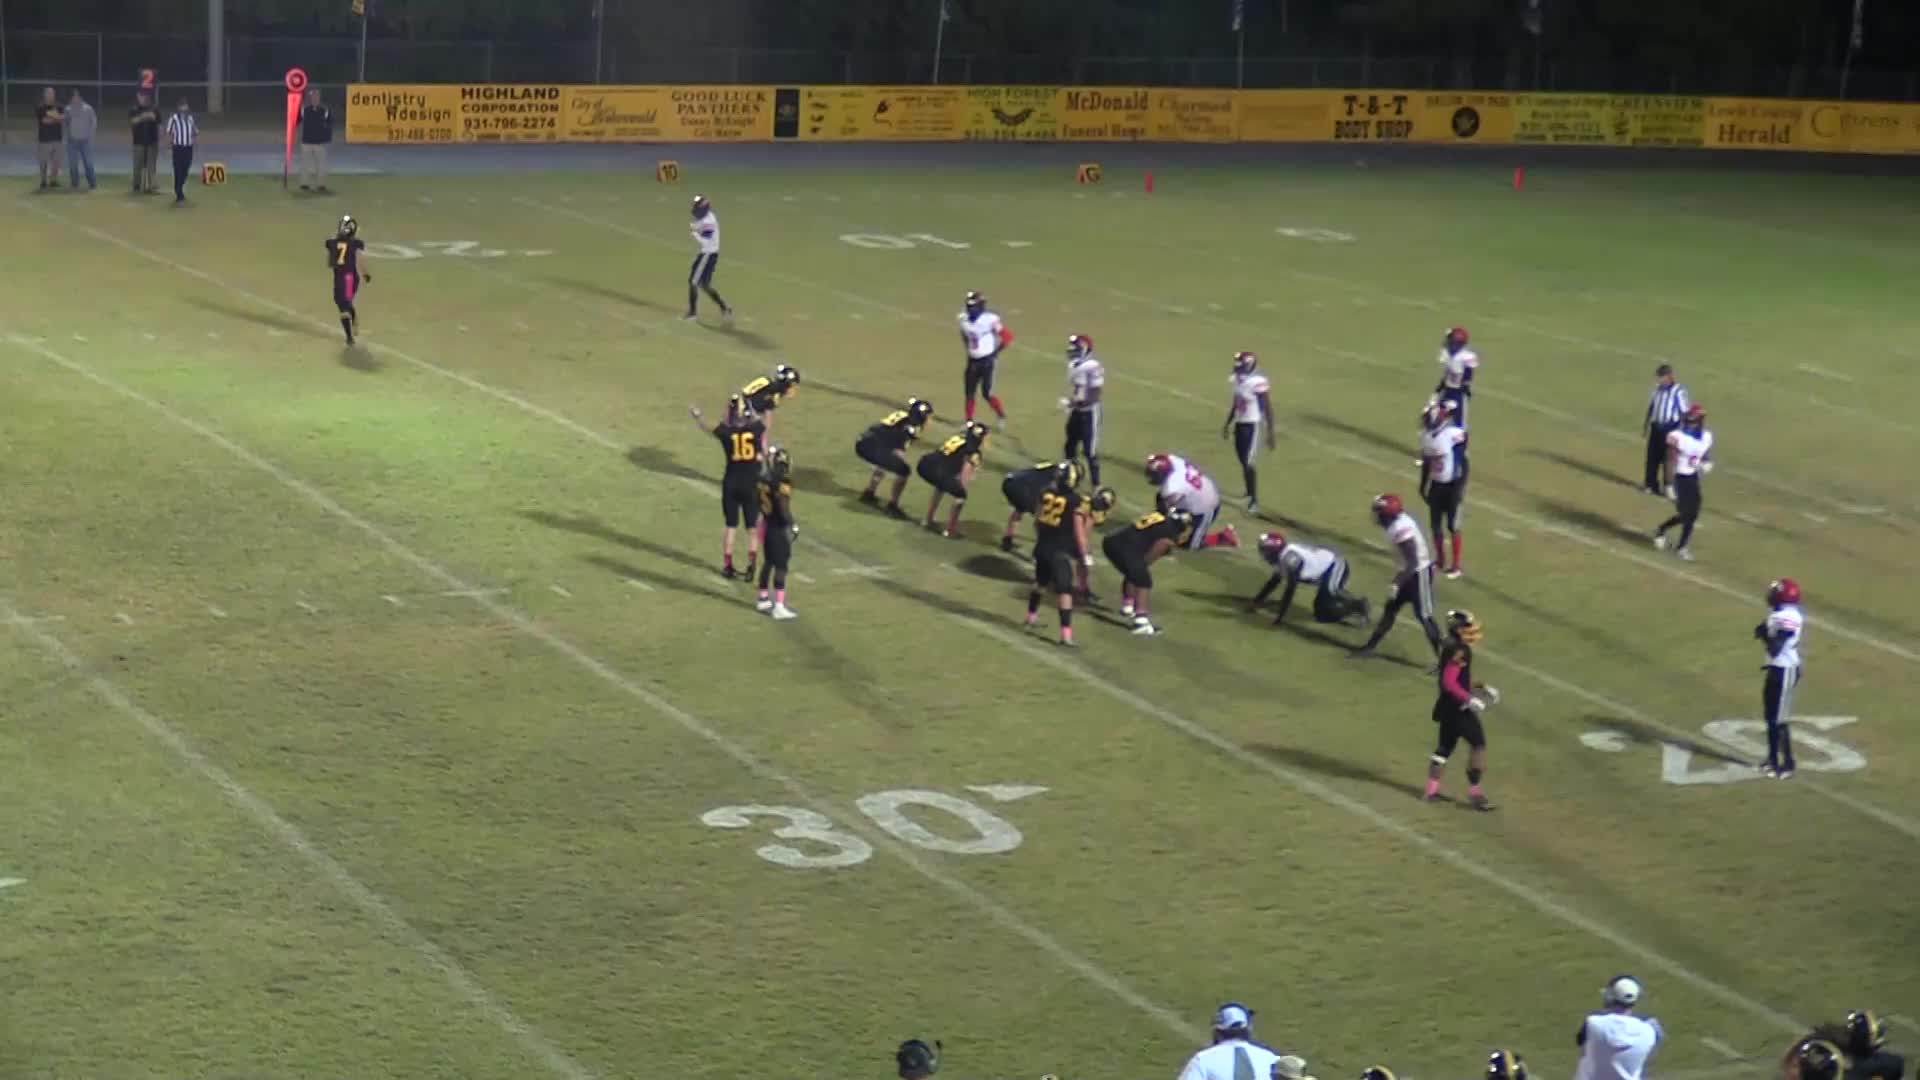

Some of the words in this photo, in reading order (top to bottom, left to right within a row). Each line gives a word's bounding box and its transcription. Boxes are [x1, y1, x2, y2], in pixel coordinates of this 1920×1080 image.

[352, 91, 426, 108] dentistry
[461, 87, 560, 100] HIGHLAND
[1065, 91, 1149, 111] McDonald
[400, 108, 451, 123] design
[461, 103, 560, 113] CORPORATION
[677, 103, 760, 115] PANTHERS
[1718, 123, 1791, 144] Herald
[207, 165, 225, 182] 20
[336, 242, 348, 266] 7
[730, 431, 755, 462] 16
[1038, 491, 1067, 527] 22
[701, 788, 1023, 869] 30
